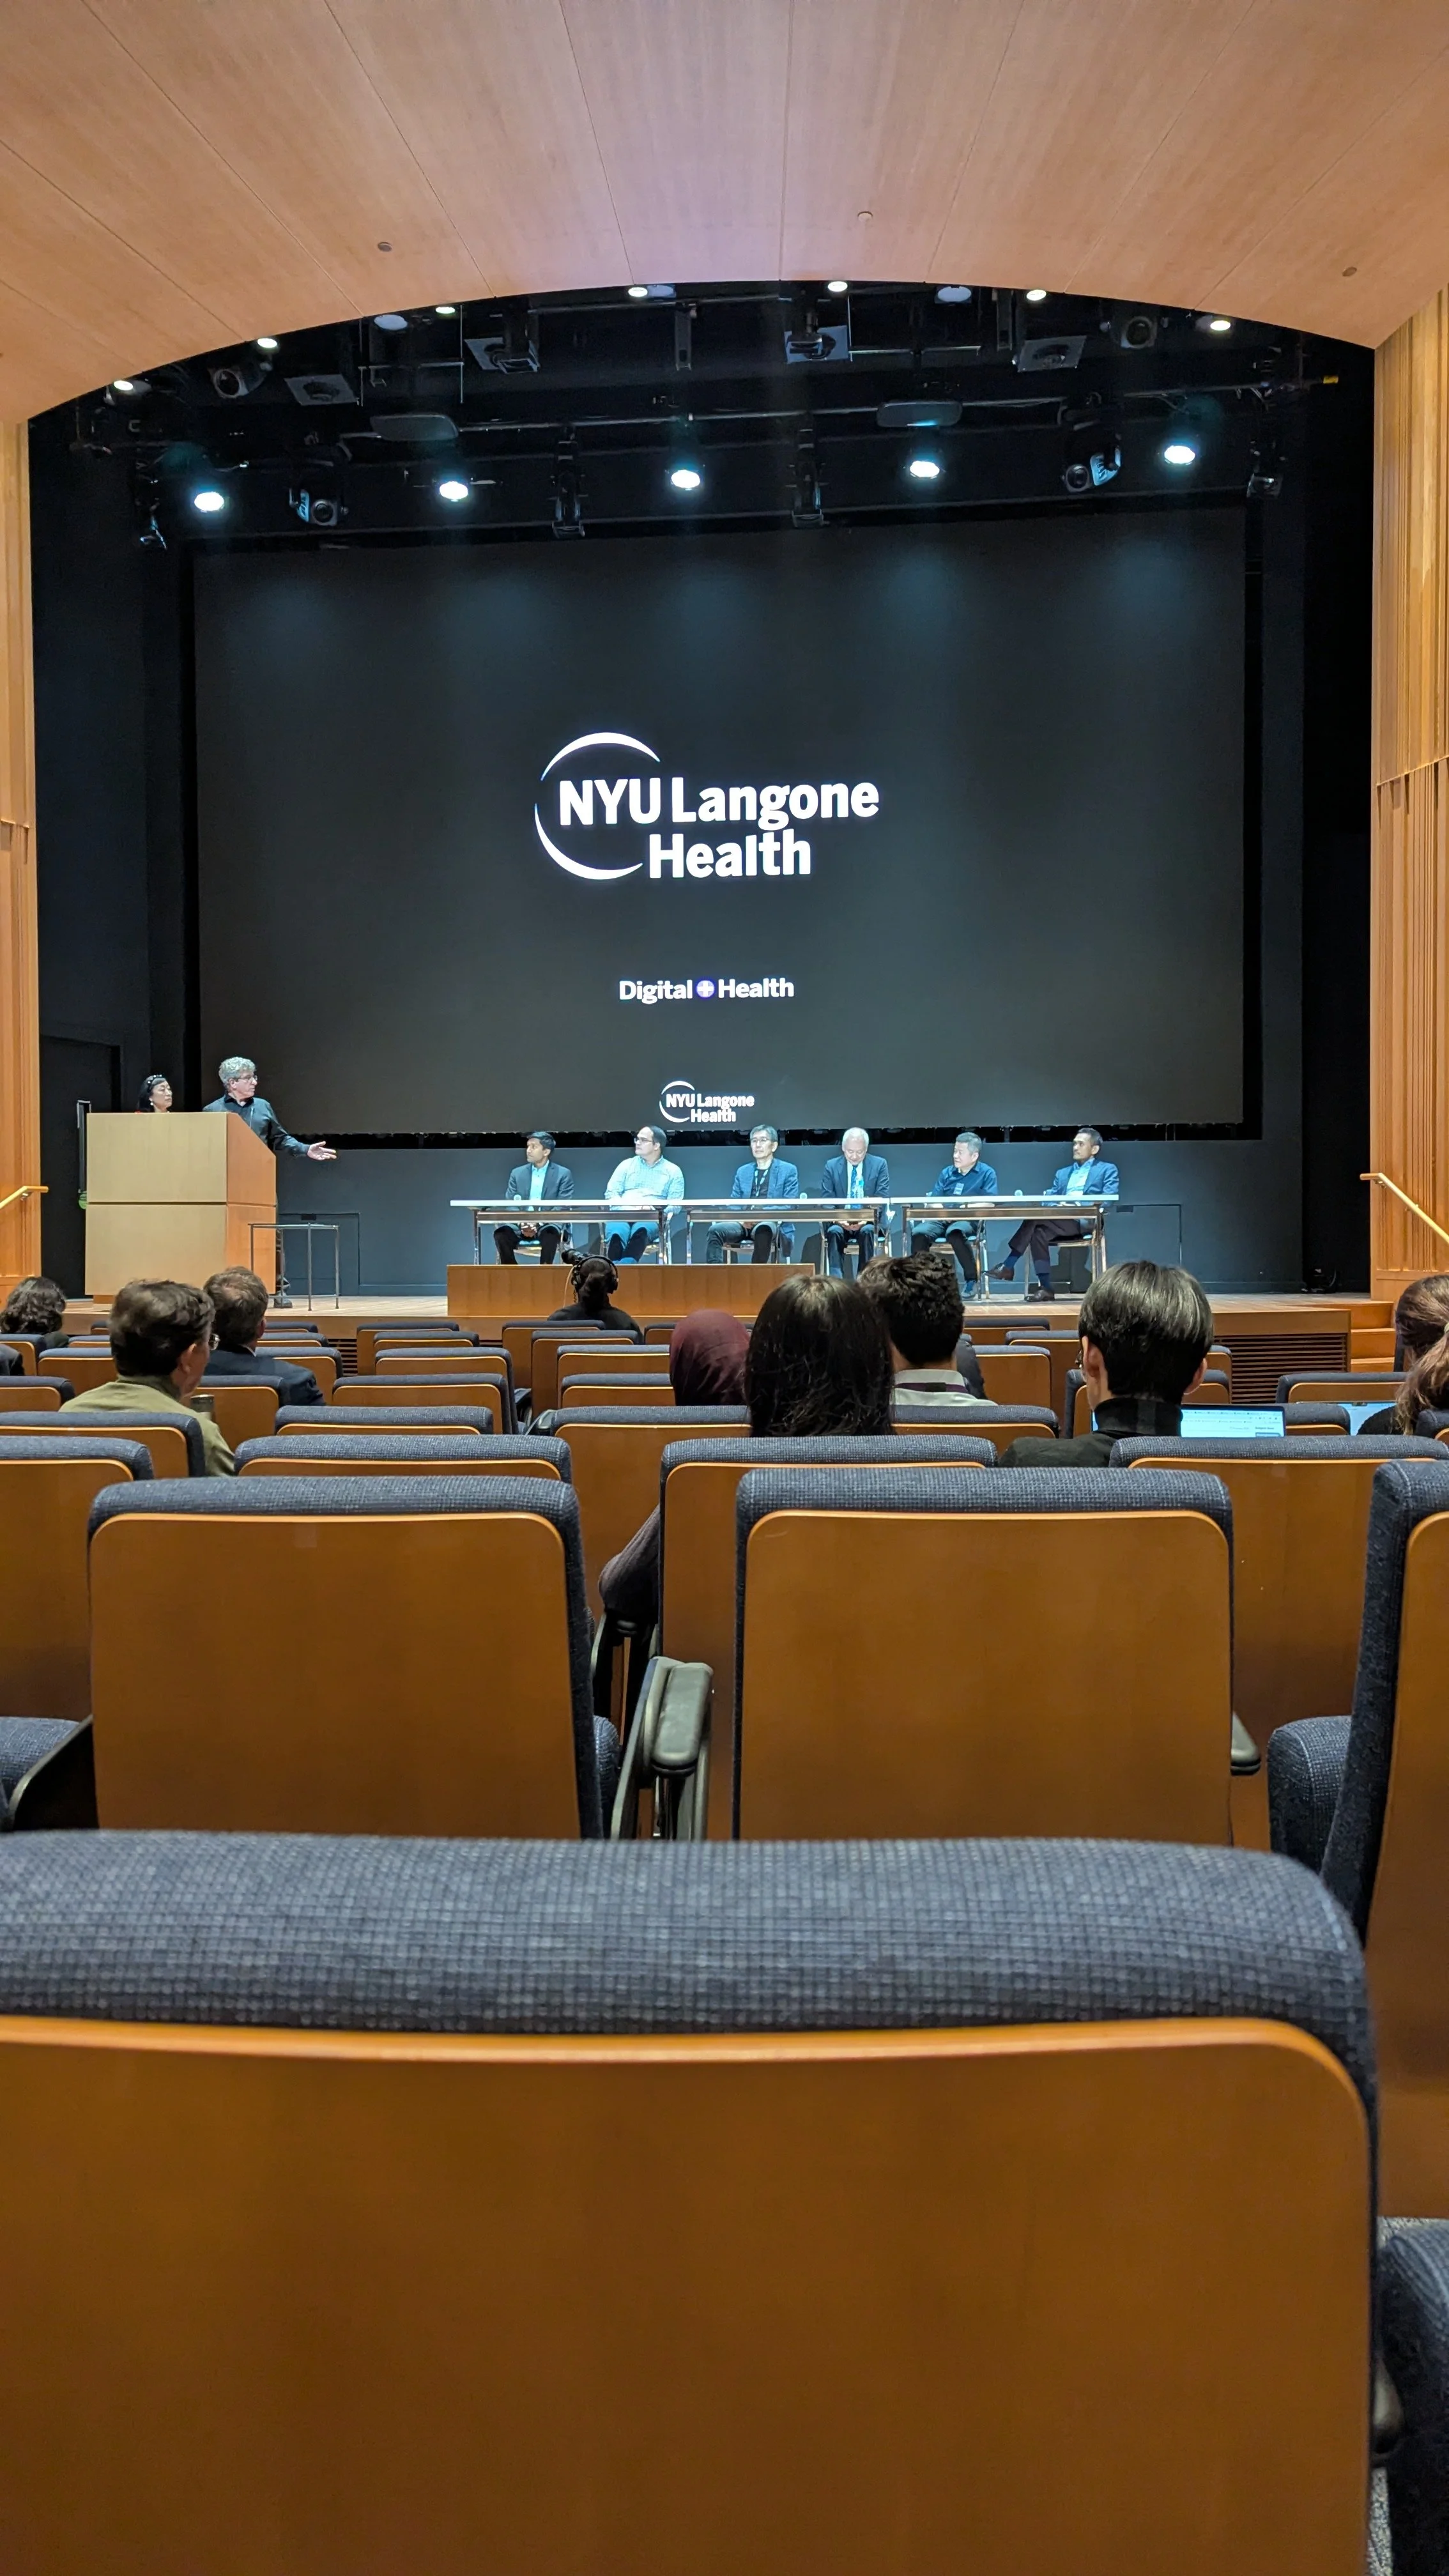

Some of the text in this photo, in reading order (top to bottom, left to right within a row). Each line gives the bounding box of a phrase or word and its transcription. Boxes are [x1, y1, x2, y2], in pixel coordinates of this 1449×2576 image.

[560, 777, 879, 831] NYU Langone
[649, 828, 811, 878] Health
[619, 977, 795, 1005] Digital Health
[666, 1093, 755, 1110] NYU Langone
[691, 1108, 737, 1123] Health
